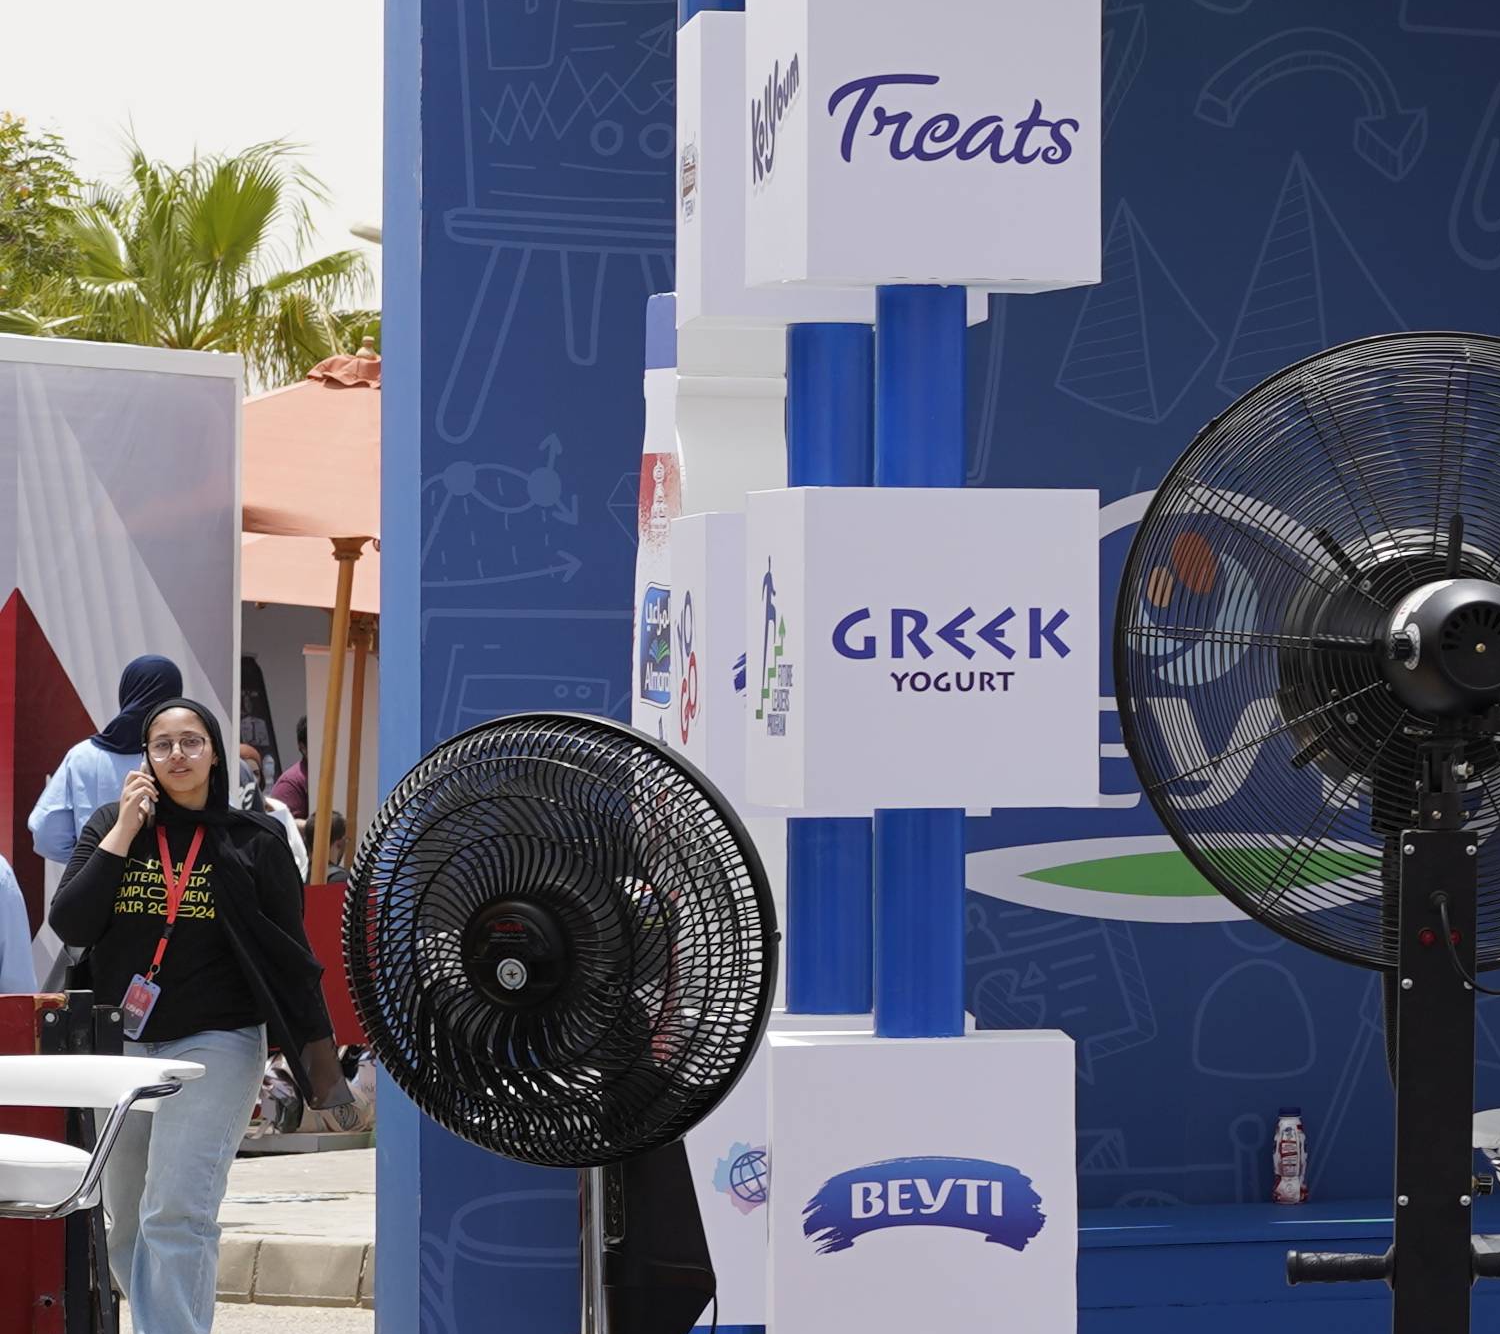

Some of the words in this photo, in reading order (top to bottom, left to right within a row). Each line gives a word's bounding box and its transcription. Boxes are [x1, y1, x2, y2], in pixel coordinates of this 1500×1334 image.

[827, 73, 1080, 165] Treats
[831, 607, 1072, 660] GREEK
[644, 661, 671, 693] Almara
[890, 671, 1015, 693] YOGURT
[850, 1178, 1003, 1221] BEYTI
